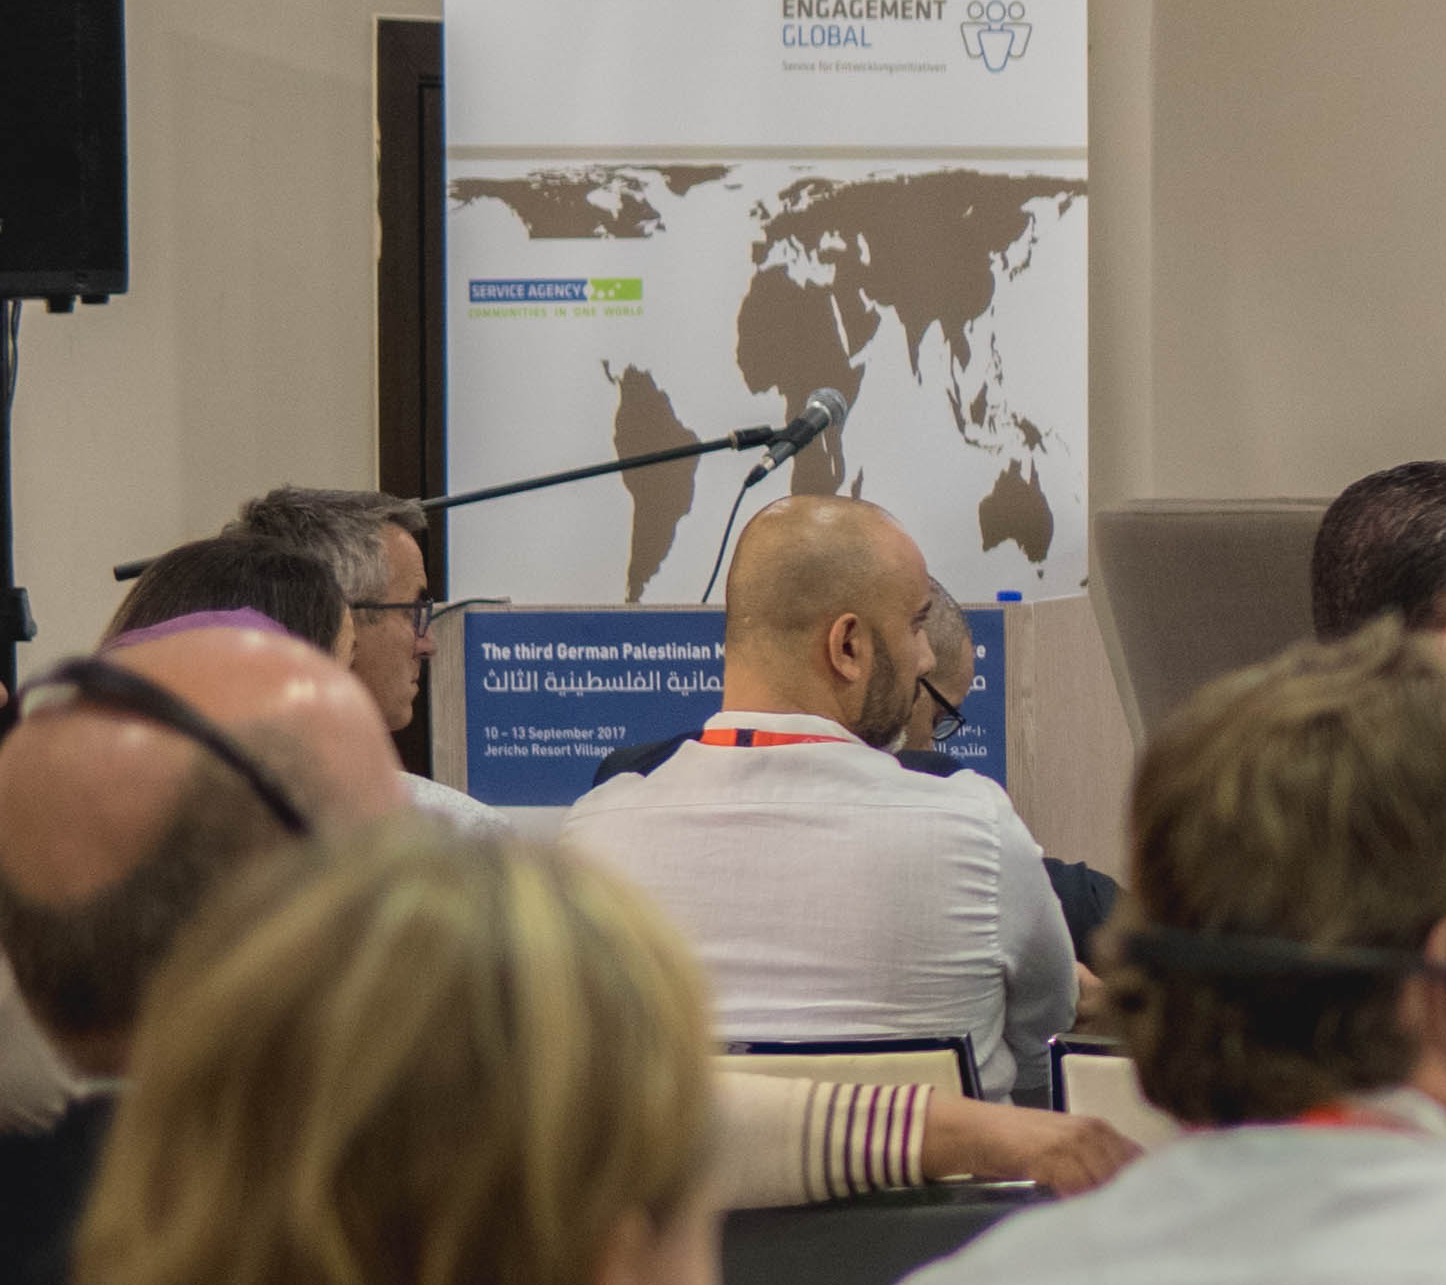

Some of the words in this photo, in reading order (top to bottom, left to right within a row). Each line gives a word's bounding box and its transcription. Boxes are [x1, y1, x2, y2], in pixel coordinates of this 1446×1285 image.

[782, 24, 873, 47] GLOBAL
[471, 283, 525, 299] SERVICE
[527, 283, 582, 299] AGENCY
[481, 643, 511, 660] The
[514, 642, 552, 660] third
[557, 643, 619, 660] German
[622, 642, 711, 660] Palestinian
[483, 669, 538, 692] الثالث
[544, 670, 661, 697] الفلسطينية
[485, 726, 499, 740] 10
[512, 726, 526, 740] 13
[528, 726, 594, 742] September
[597, 726, 627, 740] 2017
[484, 744, 529, 757] Jericho
[531, 744, 571, 757] Resort
